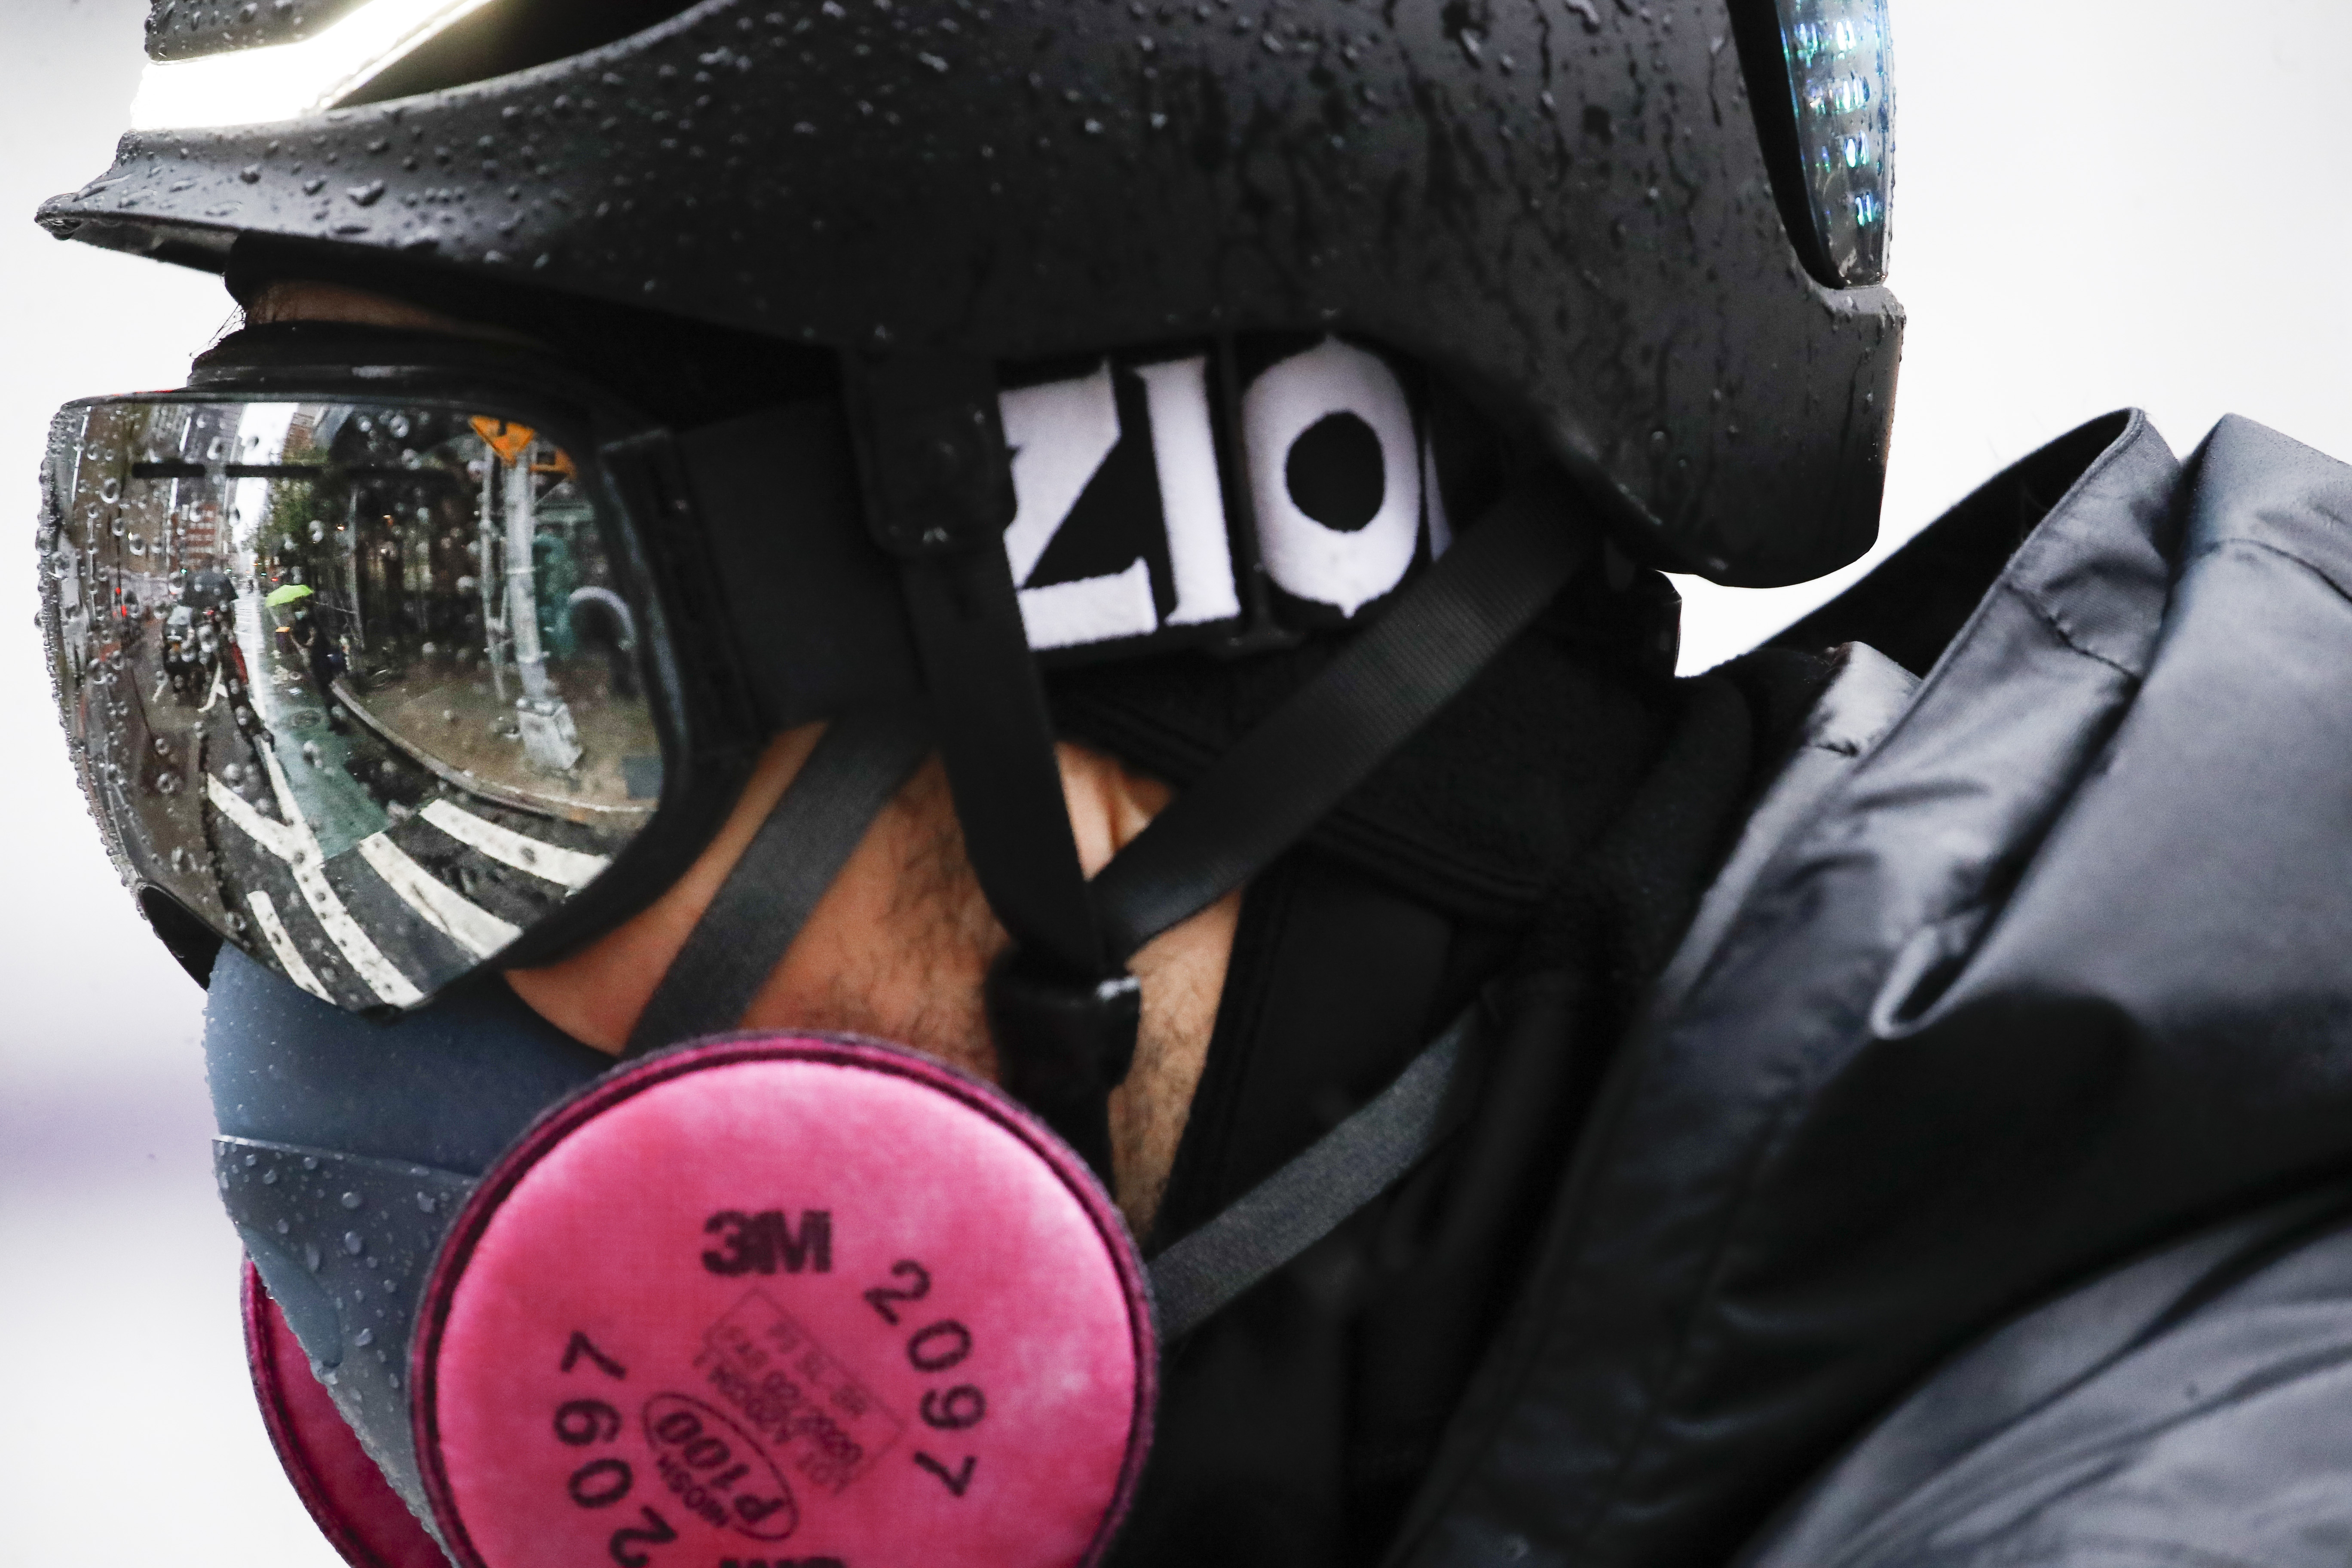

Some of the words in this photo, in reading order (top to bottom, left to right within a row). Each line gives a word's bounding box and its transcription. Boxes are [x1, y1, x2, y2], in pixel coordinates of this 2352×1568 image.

[997, 334, 1455, 650] ZIO
[701, 1209, 832, 1275] 3M
[554, 1330, 677, 1568] 2097
[863, 1259, 987, 1498] 2097
[655, 1411, 786, 1525] P100
[657, 1452, 732, 1528] NIOSH
